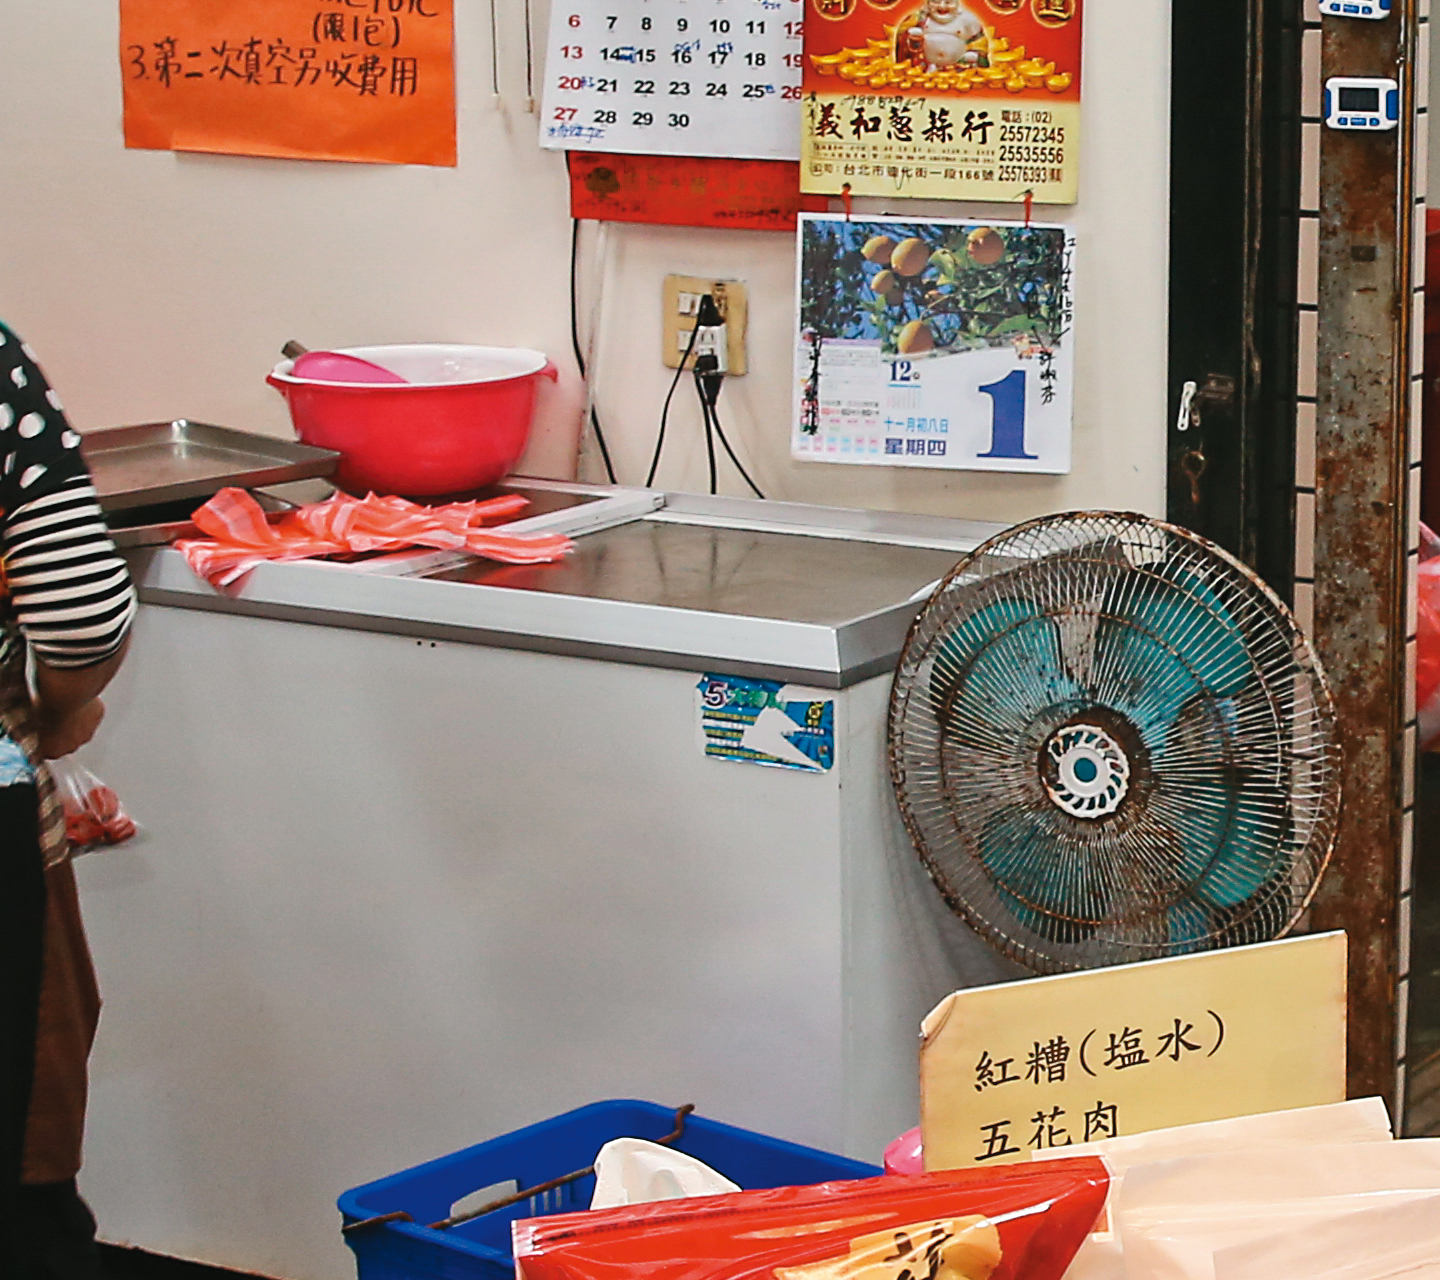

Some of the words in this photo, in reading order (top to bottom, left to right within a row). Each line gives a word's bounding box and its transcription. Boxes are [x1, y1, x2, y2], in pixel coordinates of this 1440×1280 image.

[569, 14, 580, 27] 6
[606, 16, 617, 29] 7
[642, 18, 652, 30] 8
[678, 18, 688, 32] 9
[710, 20, 730, 32] 10
[746, 22, 766, 34] 11
[561, 46, 582, 59] 13
[600, 48, 620, 61] 14
[636, 50, 656, 62] 15
[672, 51, 692, 63] 16
[709, 52, 728, 64] 17
[744, 53, 766, 66] 18
[558, 77, 582, 90] 20
[596, 80, 617, 92] 21
[634, 81, 654, 94] 22
[669, 82, 690, 95] 23
[706, 83, 727, 96] 24
[742, 85, 764, 98] 25
[554, 108, 578, 121] 27
[594, 110, 616, 124] 28
[632, 112, 653, 126] 29
[668, 114, 690, 128] 30
[1000, 125, 1065, 143] 25572345
[999, 145, 1064, 163] 25535556
[999, 165, 1047, 183] 25576393
[890, 361, 911, 381] 12
[976, 370, 1038, 459] 1
[884, 417, 949, 434] 十一月初八日
[885, 438, 946, 455] 星期四
[972, 1008, 1226, 1093] 紅糟(塩水)
[977, 1101, 1121, 1163] 五花肉
